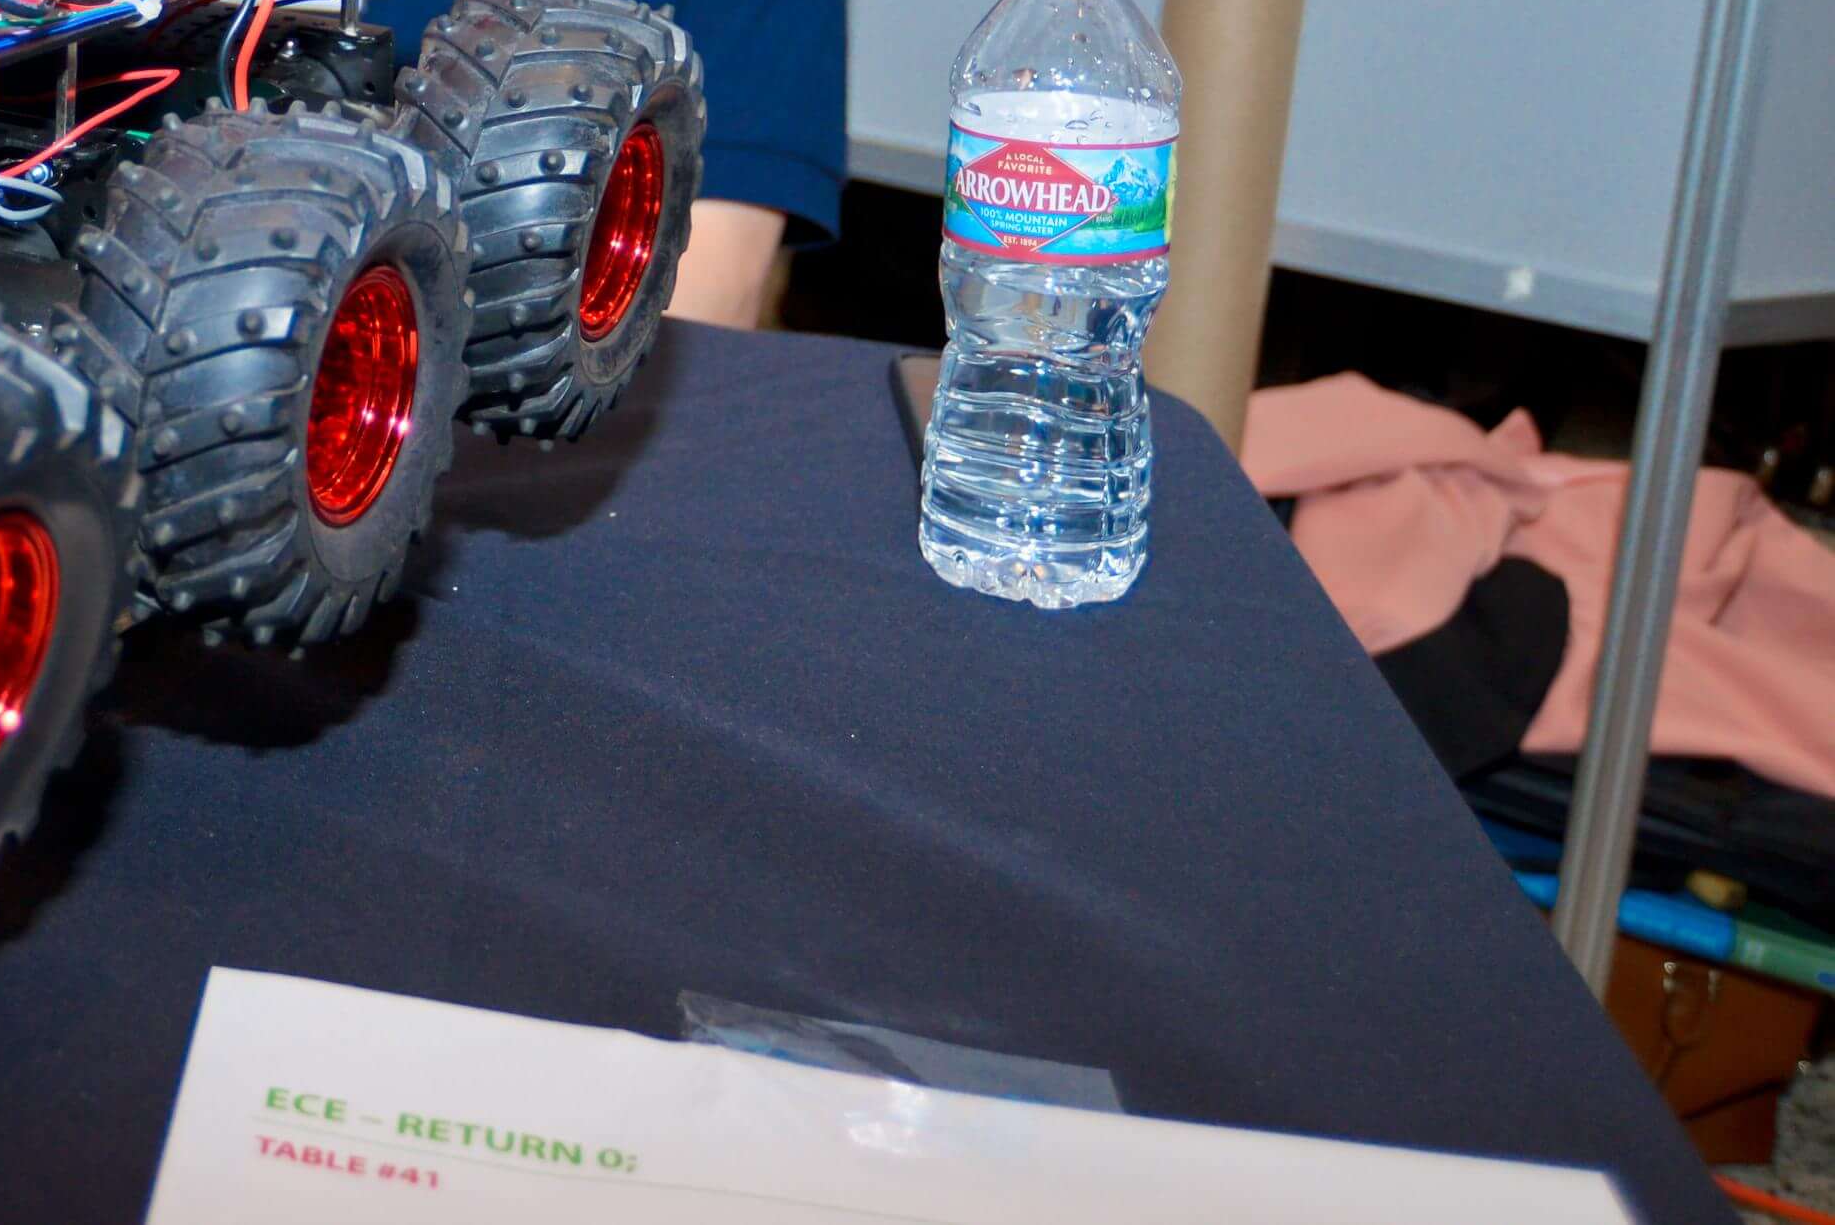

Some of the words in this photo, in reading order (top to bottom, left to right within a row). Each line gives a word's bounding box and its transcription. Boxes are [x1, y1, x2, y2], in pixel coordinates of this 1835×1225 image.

[1005, 152, 1013, 161] A
[1014, 153, 1045, 165] LOCAL
[997, 160, 1053, 176] FAVORITE
[955, 167, 1111, 214] ARROWHEAD
[980, 207, 1003, 220] 100%
[1005, 211, 1068, 228] MOUNTAIN
[991, 220, 1021, 232] SPRING
[1023, 223, 1054, 235] WATER
[1003, 235, 1018, 245] EST.
[1020, 237, 1038, 247] 1894
[266, 1086, 347, 1123] ECE
[396, 1112, 584, 1166] RETURN
[255, 1134, 368, 1177] TABLE
[377, 1162, 440, 1190] #41
